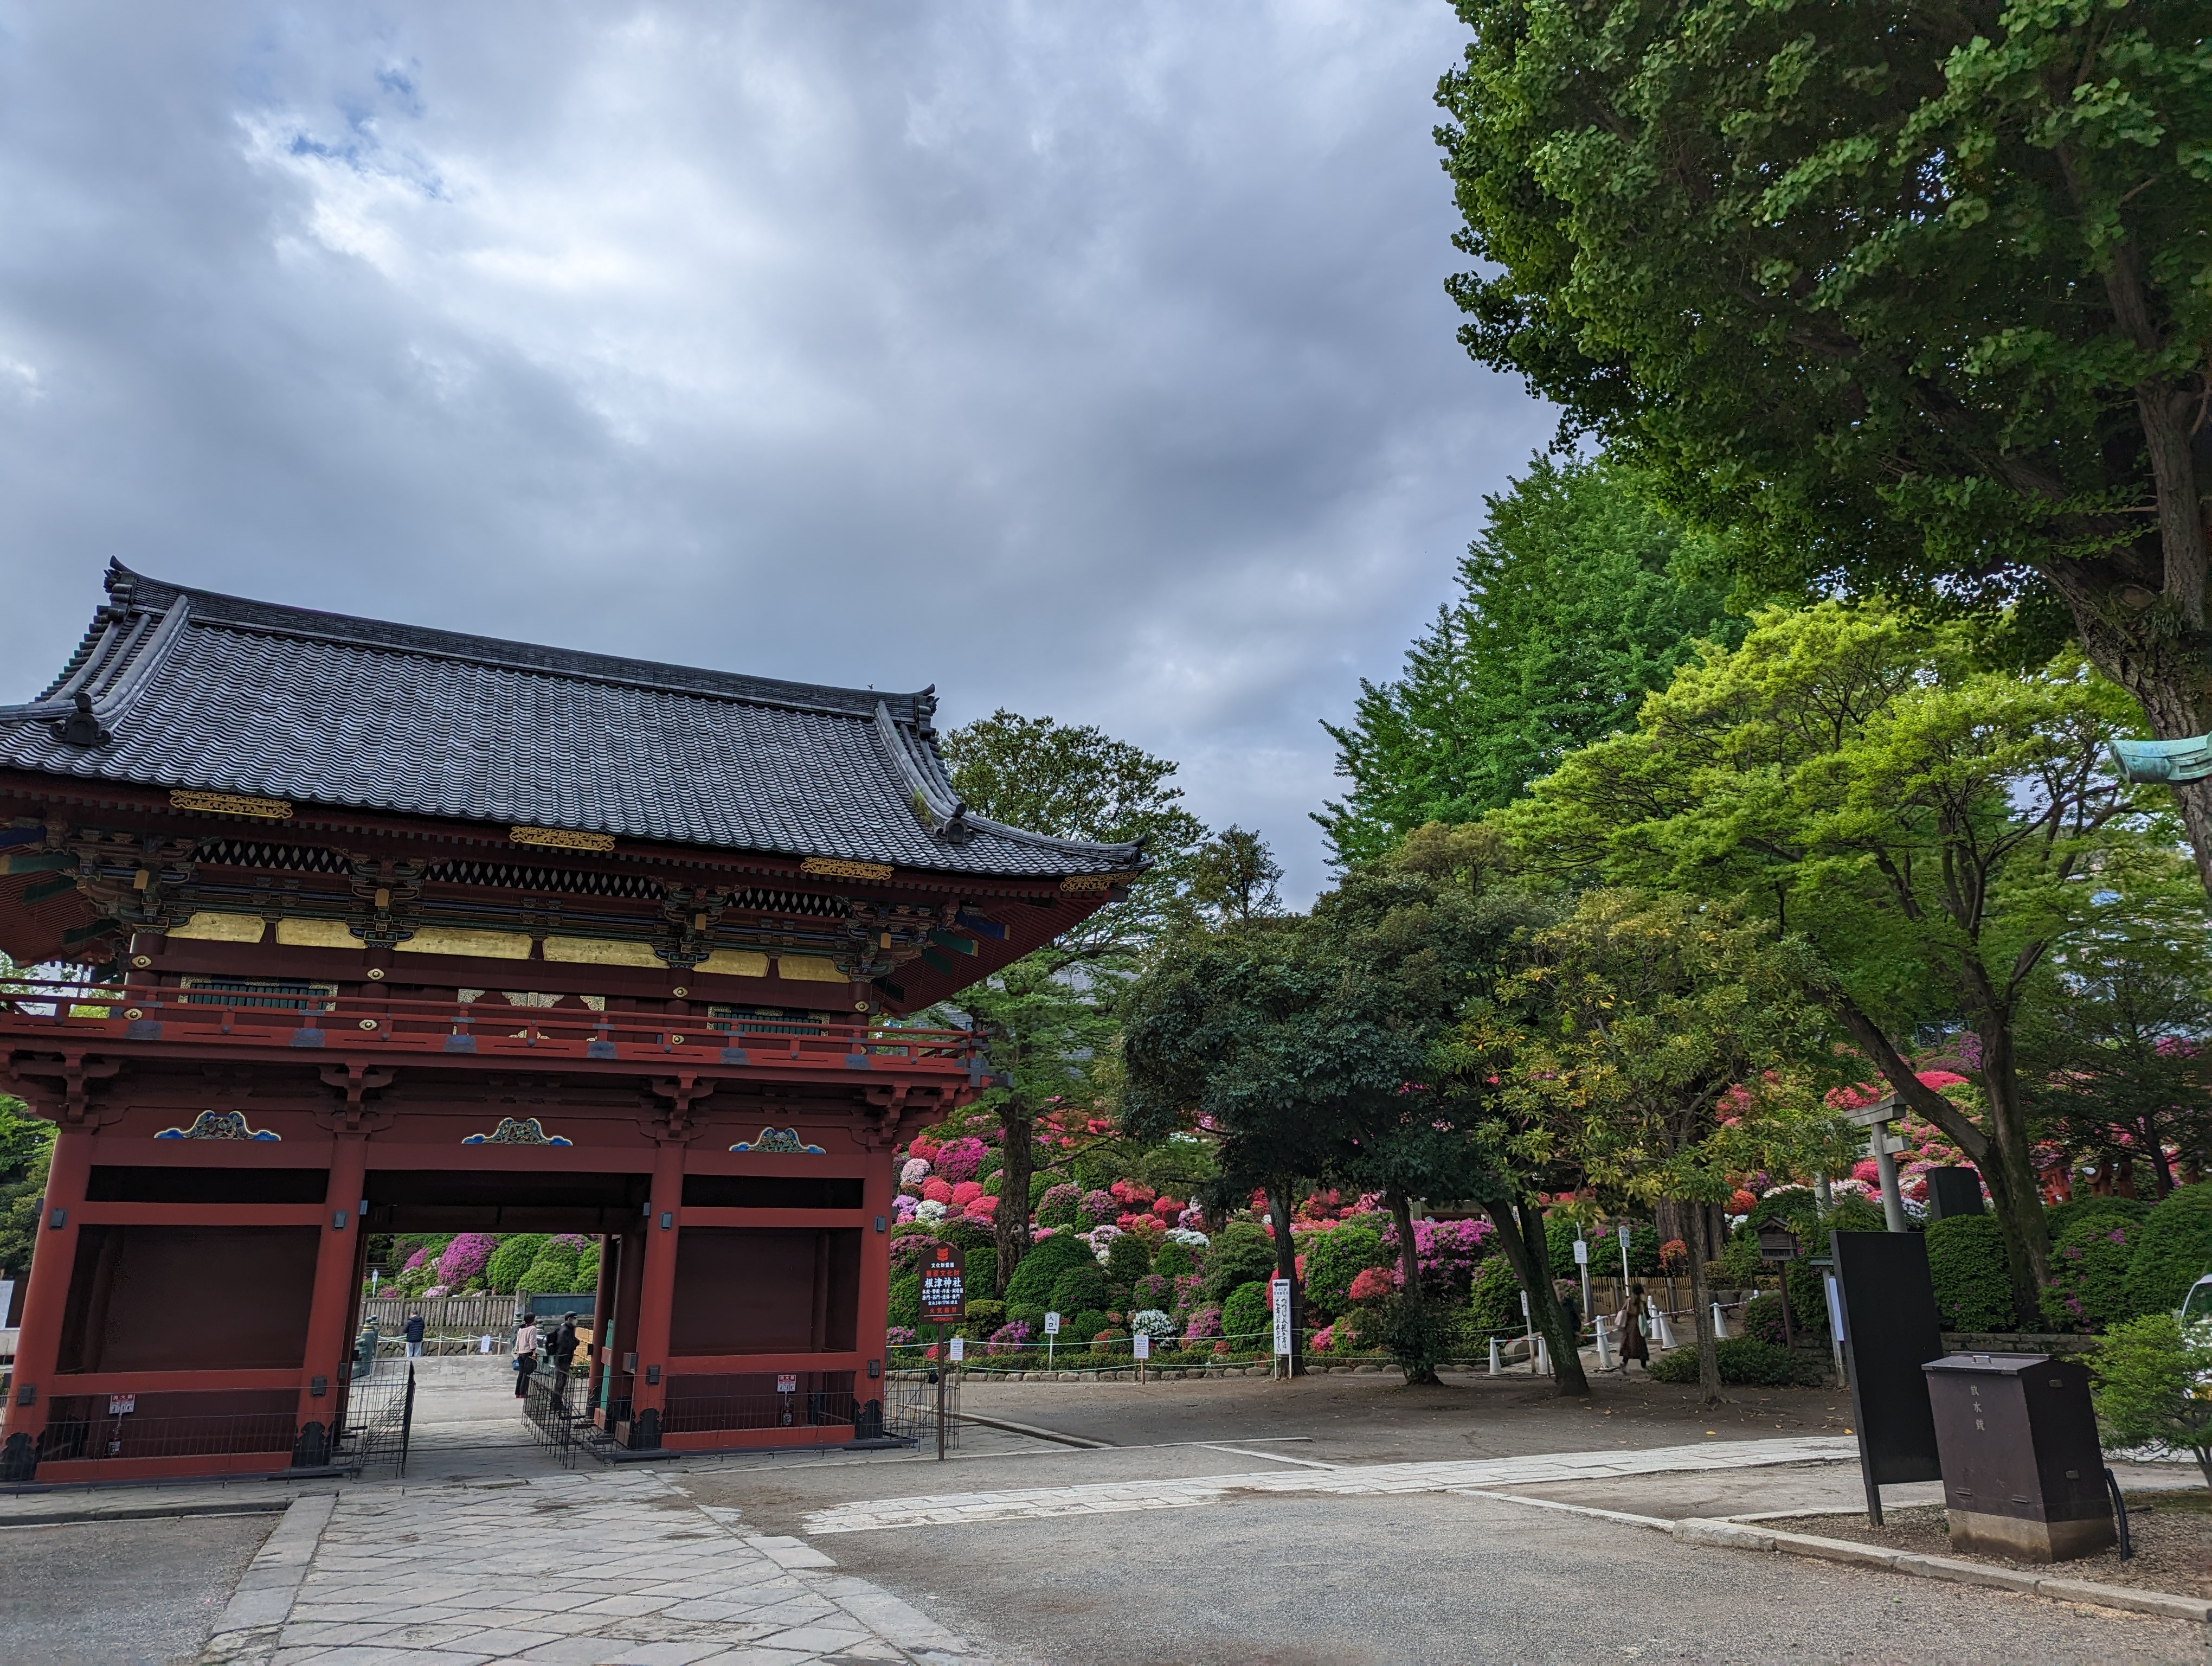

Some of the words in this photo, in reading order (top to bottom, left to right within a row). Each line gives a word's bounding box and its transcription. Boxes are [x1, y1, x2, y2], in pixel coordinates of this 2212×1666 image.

[924, 1277, 962, 1289] 根津神社
[1048, 1314, 1054, 1328] 入口
